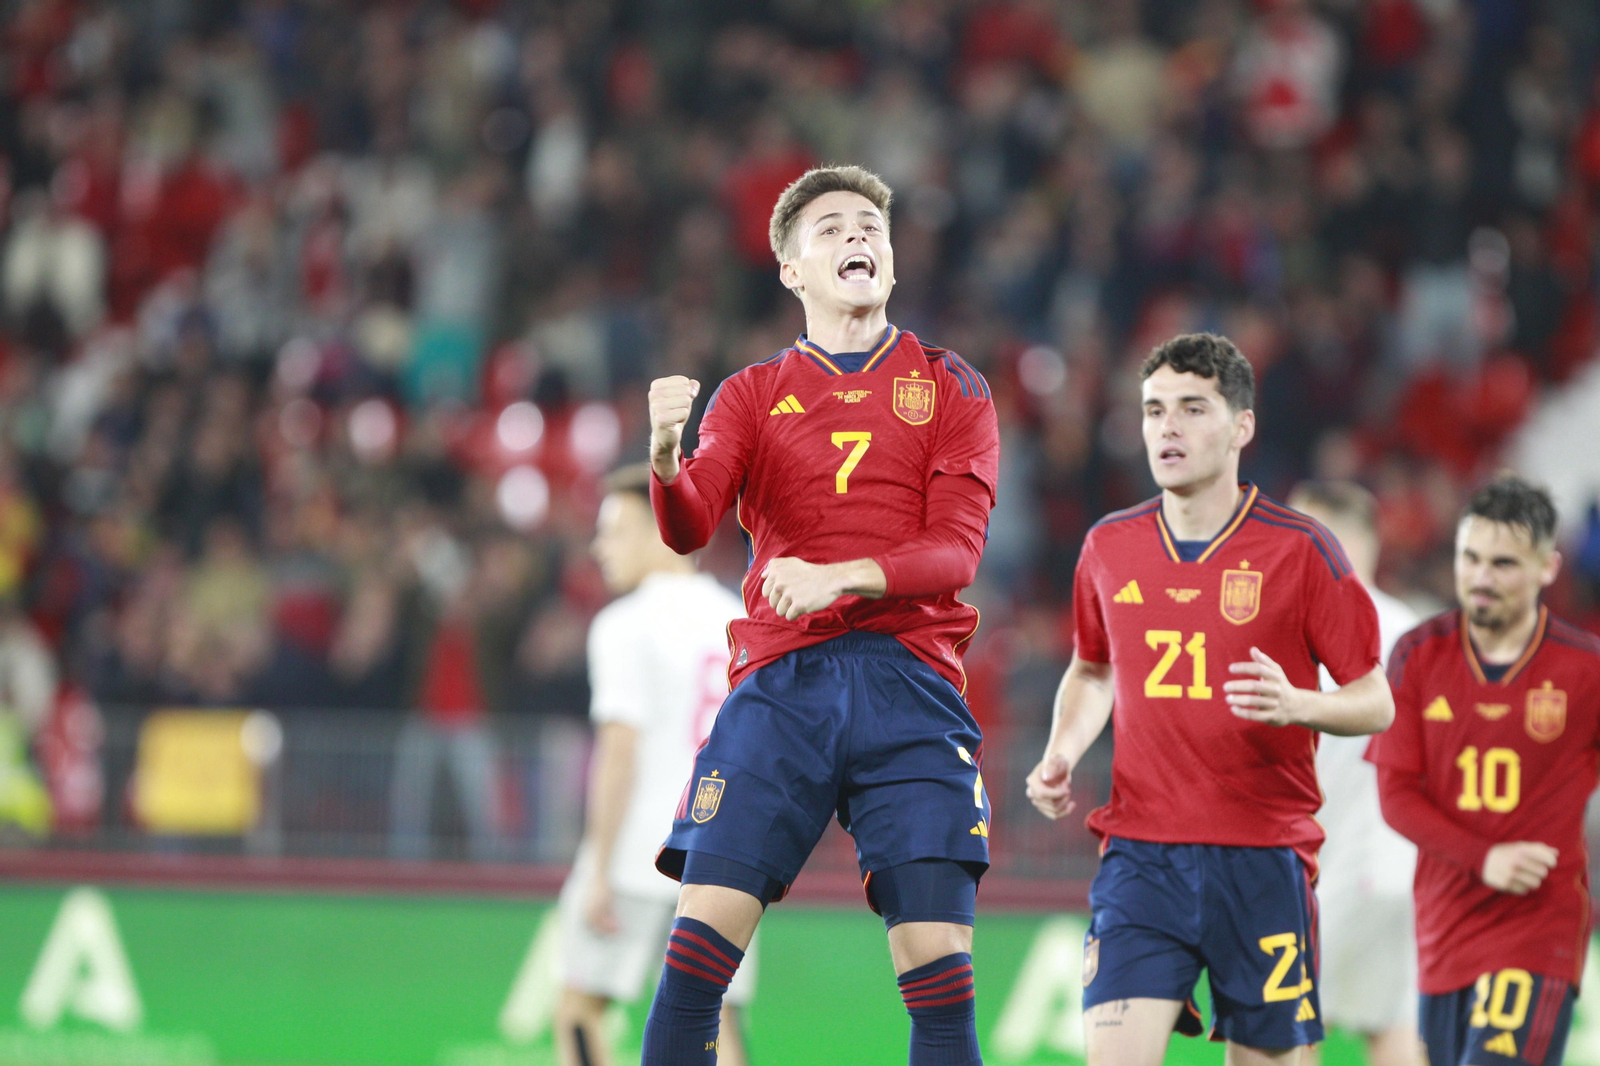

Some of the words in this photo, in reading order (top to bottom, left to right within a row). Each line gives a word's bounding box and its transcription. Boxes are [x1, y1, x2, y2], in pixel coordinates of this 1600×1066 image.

[831, 431, 872, 494] 7
[1144, 630, 1213, 700] 21
[1456, 745, 1521, 813] 10
[19, 887, 146, 1032] A
[1469, 967, 1534, 1031] 10
